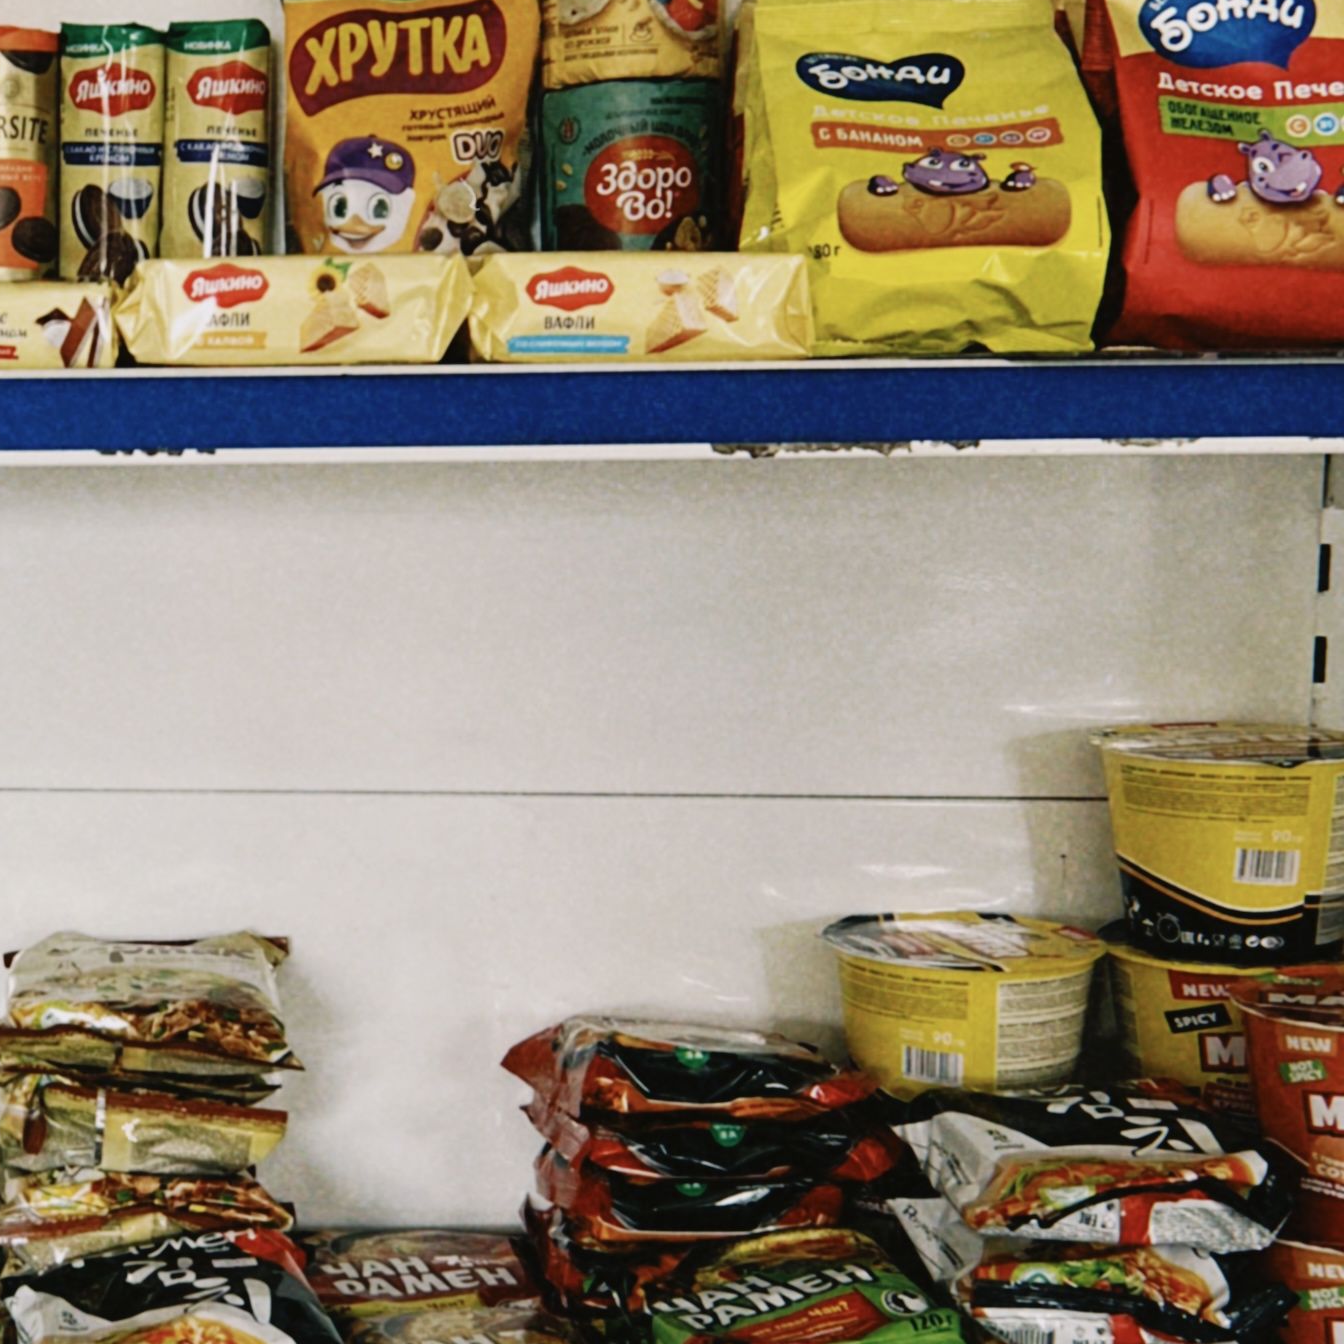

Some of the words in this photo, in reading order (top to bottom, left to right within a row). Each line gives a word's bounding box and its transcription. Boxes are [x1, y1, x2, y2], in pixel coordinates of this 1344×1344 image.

[184, 40, 232, 51] НОВИНКА
[304, 13, 491, 96] ХРУТКА
[75, 77, 151, 103] Яшкино
[195, 76, 266, 101] Яшкино
[1158, 72, 1263, 100] Детское
[410, 95, 496, 121] ХРУСТЯЩИЙ
[812, 105, 921, 127] Детское
[931, 105, 1050, 127] Печенье
[1167, 100, 1261, 126] ОБОГАЩЕННОЕ
[819, 128, 830, 141] С
[836, 129, 924, 147] БАНАНОМ
[1170, 119, 1235, 137] ЖЕЛЕЗОМ
[596, 162, 692, 198] Здоро
[616, 188, 674, 222] Во!
[190, 273, 263, 300] Яшкино
[534, 277, 609, 304] Яшкино
[543, 314, 596, 332] ВАФЛИ
[1174, 1012, 1217, 1028] SPICY
[932, 1031, 953, 1045] 90
[1285, 1035, 1331, 1053] NEW
[1289, 1060, 1313, 1072] NOT
[1289, 1070, 1323, 1083] SPICY
[320, 1255, 430, 1279] ЧАН
[334, 1267, 518, 1297] РАМЕН
[653, 1275, 772, 1315] ЧАН
[678, 1263, 875, 1331] РАМЕН
[1310, 1289, 1338, 1301] NOT
[909, 1314, 943, 1334] 120
